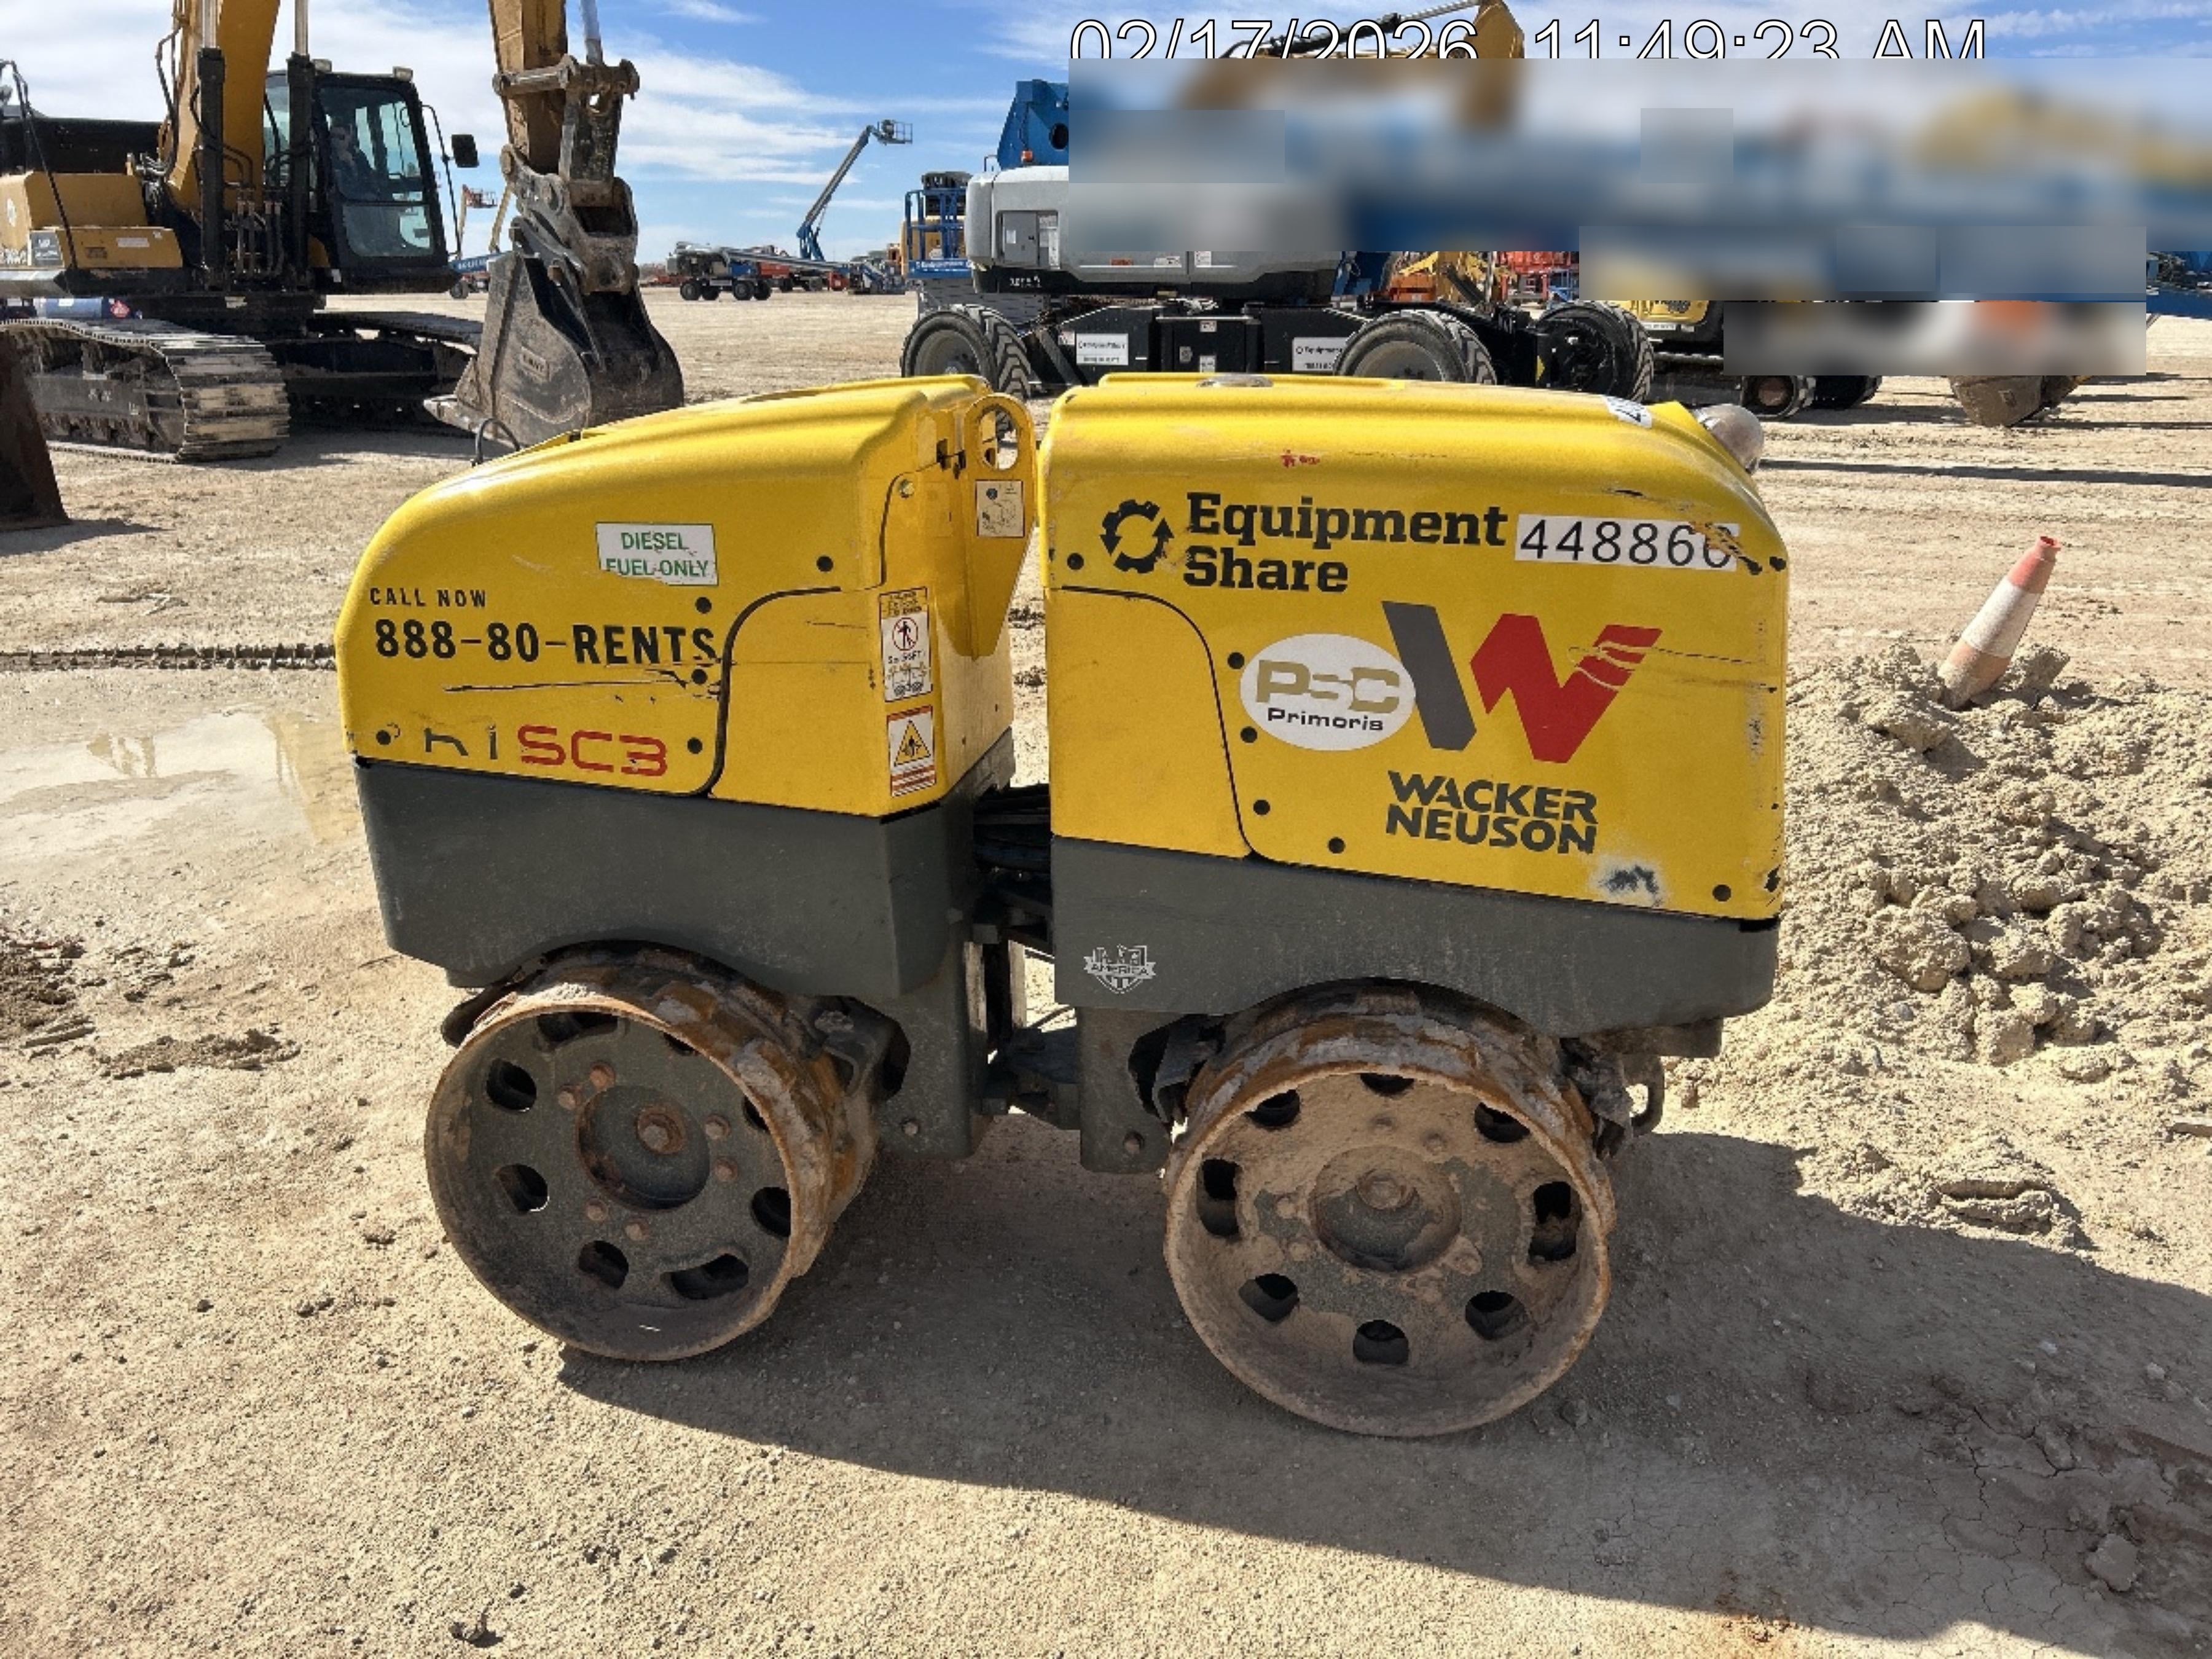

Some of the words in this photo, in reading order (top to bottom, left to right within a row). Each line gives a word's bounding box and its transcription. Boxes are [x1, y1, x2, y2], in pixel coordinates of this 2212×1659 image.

[621, 531, 689, 550] DIESEL
[1187, 492, 1508, 550] Equipment
[606, 557, 655, 576] FUEL
[659, 559, 708, 578] ONLY
[1183, 544, 1348, 592] Share
[370, 587, 425, 606] CALL
[437, 589, 486, 607] NOW
[375, 619, 716, 664] 888-80-RENTS
[1267, 707, 1384, 731] Primoris
[1387, 770, 1599, 825] WACKER
[1386, 803, 1597, 855] NEUSON
